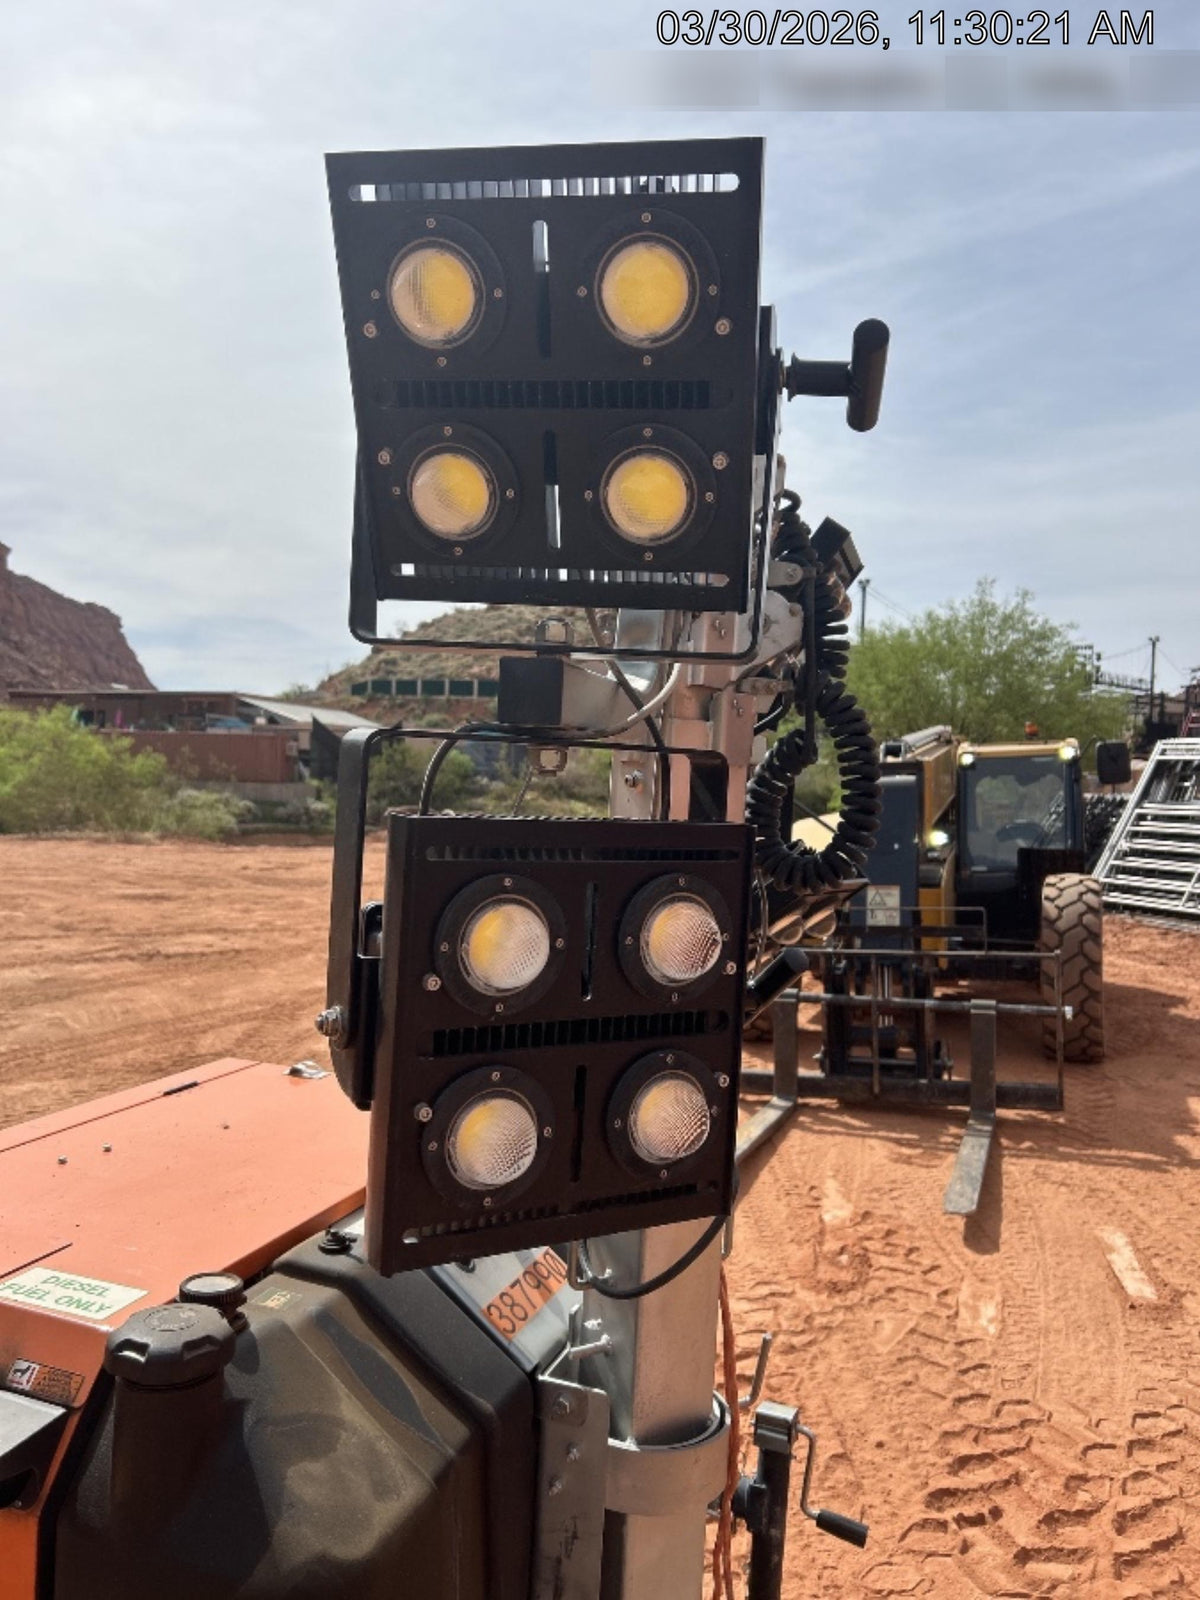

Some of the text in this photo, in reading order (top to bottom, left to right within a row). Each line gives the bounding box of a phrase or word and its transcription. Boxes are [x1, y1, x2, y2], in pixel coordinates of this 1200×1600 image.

[0, 1283, 113, 1313] FUEL ONLY
[41, 1275, 110, 1298] DIESEL
